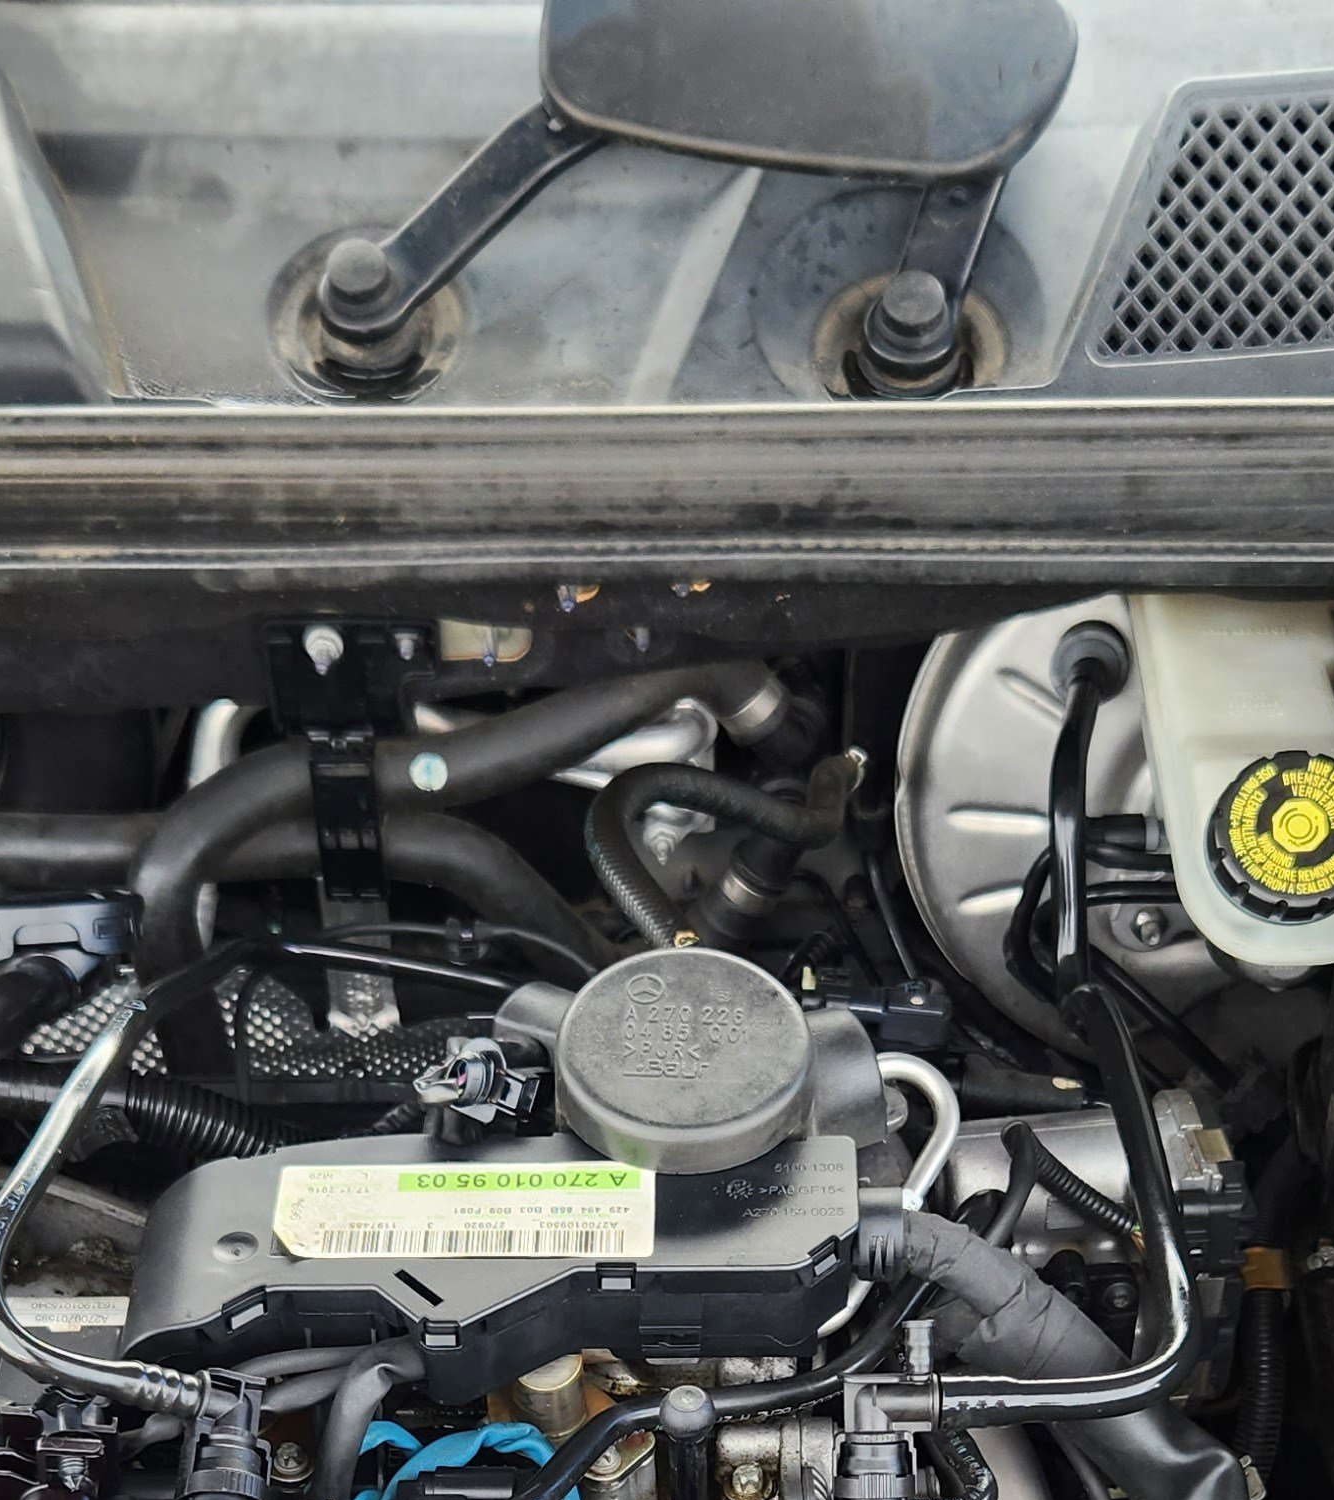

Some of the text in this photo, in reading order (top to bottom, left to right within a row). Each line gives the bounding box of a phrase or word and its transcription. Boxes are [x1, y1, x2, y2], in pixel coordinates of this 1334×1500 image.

[1255, 763, 1276, 782] USE
[1308, 758, 1334, 776] NUR
[1239, 777, 1258, 800] ONLY
[1242, 789, 1267, 817] CLEAN
[1241, 817, 1257, 849] FILLER
[1229, 828, 1247, 859] BRAKE
[1262, 860, 1297, 882] BEFORE
[1261, 873, 1286, 893] FROM
[1287, 881, 1295, 894] A
[1296, 878, 1330, 895] SEALED
[625, 1004, 745, 1027] A 270 226
[812, 1163, 845, 1173] 1308
[416, 1172, 629, 1190] A 270 010 95 03
[810, 1207, 845, 1217] 0025
[463, 1221, 506, 1230] 270920
